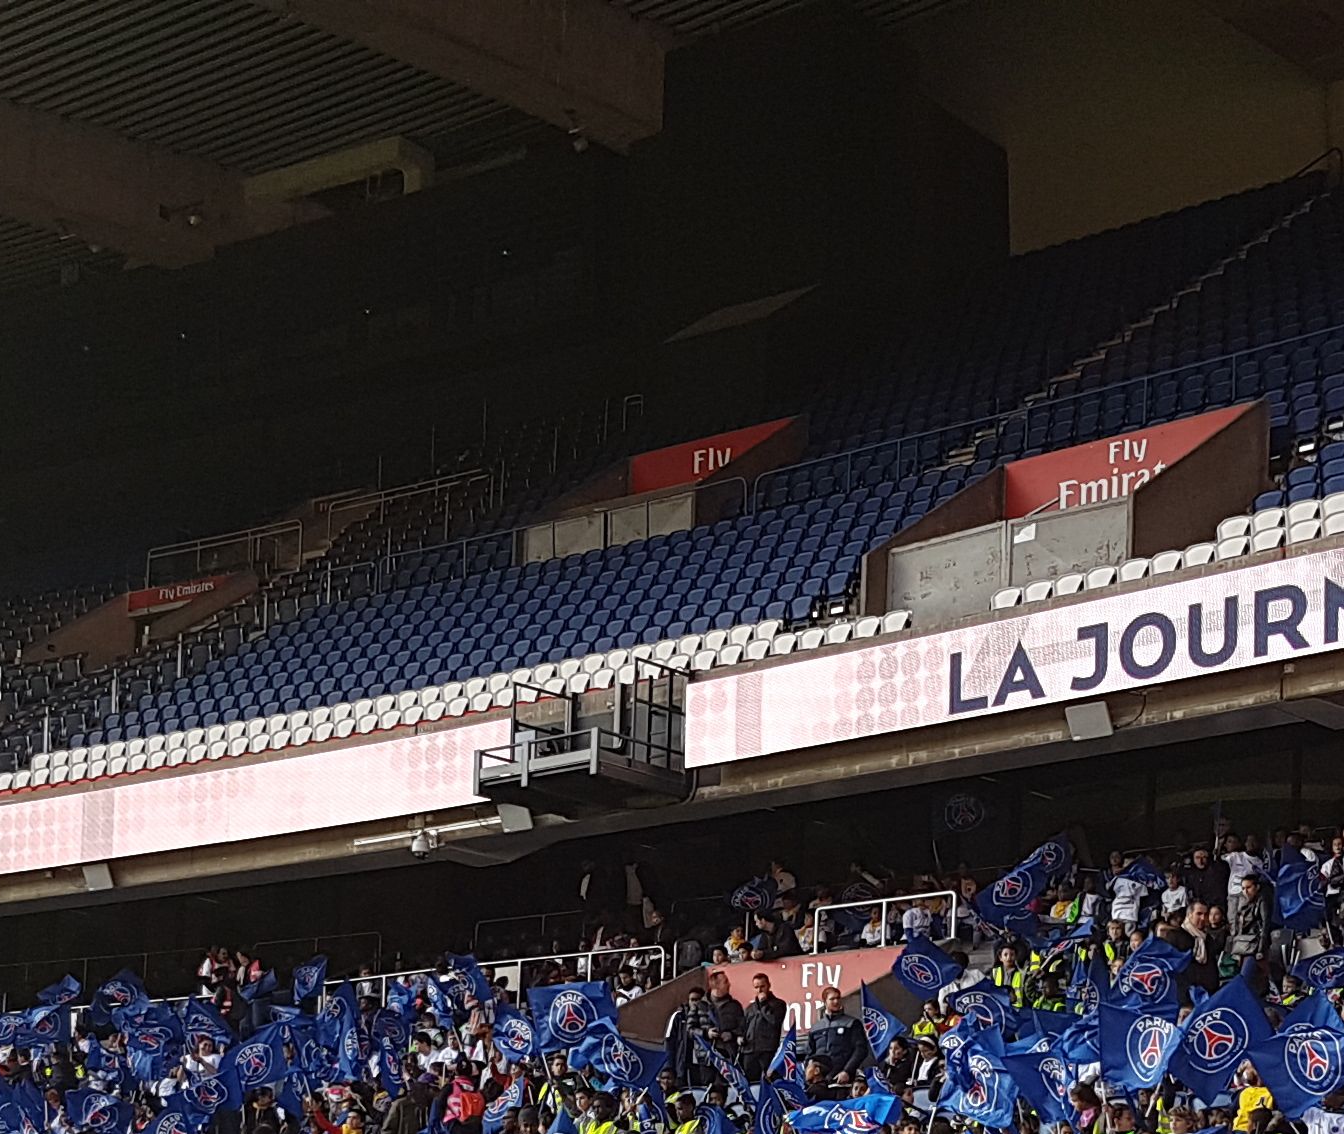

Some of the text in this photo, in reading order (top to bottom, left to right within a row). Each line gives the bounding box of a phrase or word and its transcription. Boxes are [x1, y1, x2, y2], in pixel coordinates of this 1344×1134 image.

[1109, 438, 1147, 464] Fly
[159, 580, 215, 600] Fly Emirates
[948, 642, 1046, 716] LA
[801, 962, 840, 989] Fly
[555, 993, 583, 1008] PARIS
[1136, 1016, 1172, 1034] PARIS
